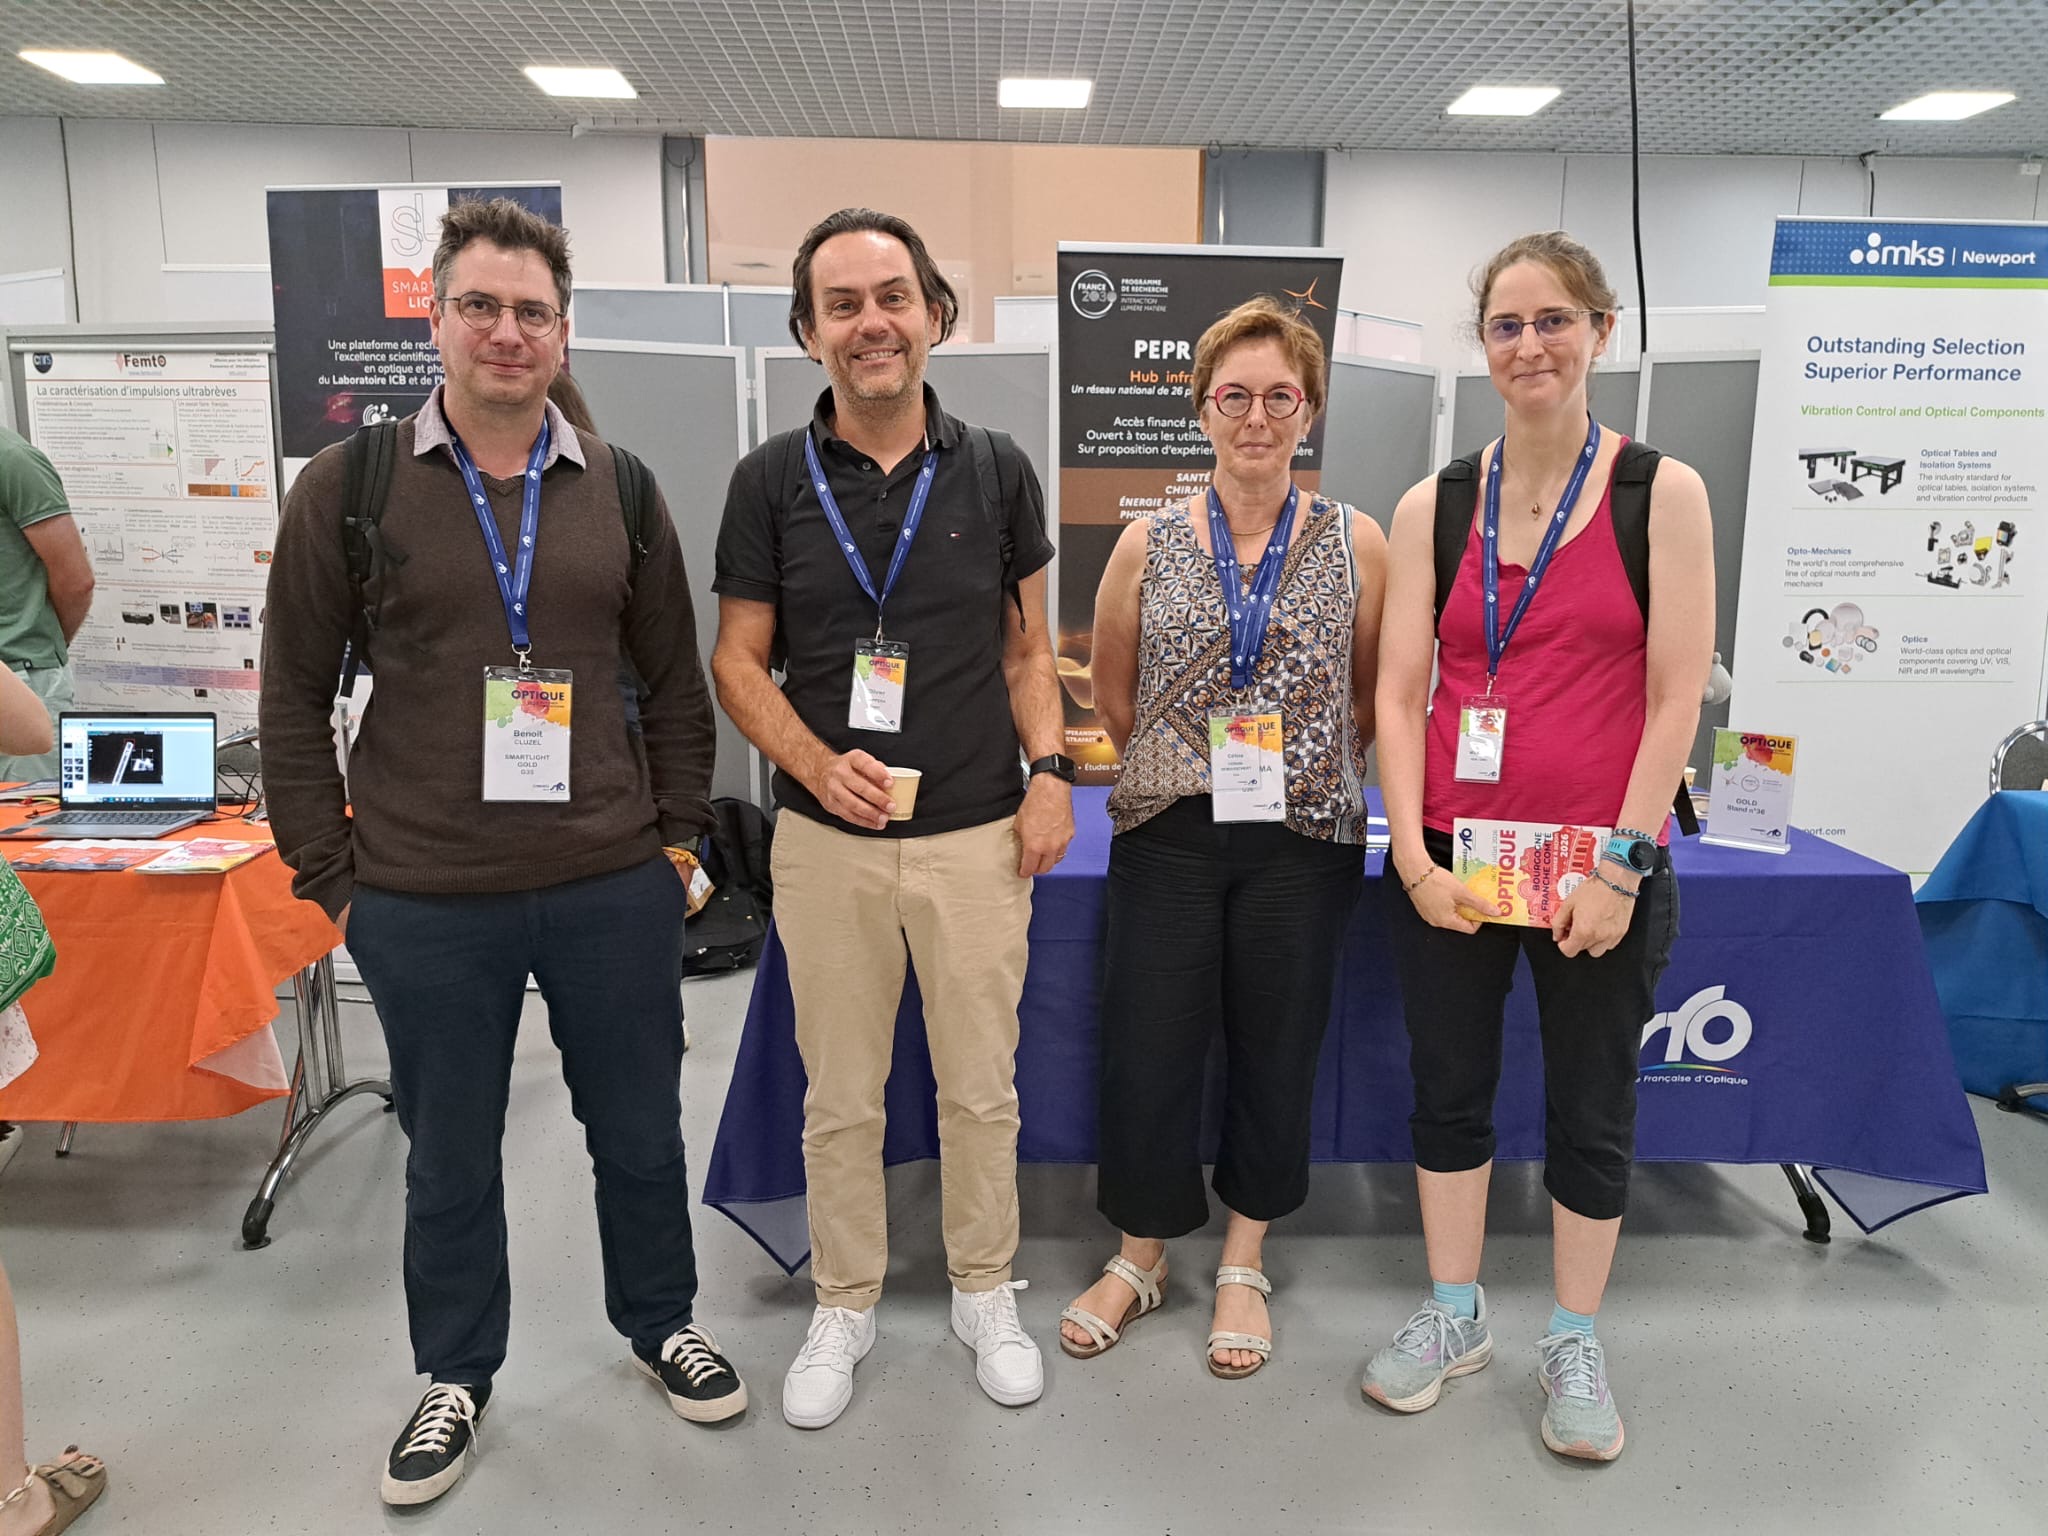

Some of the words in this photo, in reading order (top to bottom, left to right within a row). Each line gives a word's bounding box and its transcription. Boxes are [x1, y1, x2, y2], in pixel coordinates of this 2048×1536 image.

[1881, 240, 1945, 267] mks
[1962, 250, 2036, 267] Newport
[1077, 282, 1107, 291] FRANCE
[1121, 278, 1162, 286] PROGRAMME
[328, 339, 347, 349] Une
[349, 339, 399, 351] plateforme
[400, 339, 413, 349] de
[1134, 339, 1191, 360] PEPR
[1807, 336, 1926, 359] Outstanding
[1932, 338, 2026, 355] Selection
[334, 351, 386, 361] l'excellence
[388, 351, 441, 362] scientifique
[364, 365, 376, 373] en
[377, 363, 413, 375] optique
[415, 364, 425, 373] et
[1804, 362, 1889, 383] Superior
[1893, 363, 2022, 381] Performance
[318, 375, 330, 385] du
[332, 374, 387, 385] Laboratoire
[388, 375, 407, 385] ICB
[408, 375, 419, 385] et
[420, 375, 432, 385] de
[1130, 370, 1159, 383] Hub
[37, 385, 48, 396] La
[49, 385, 119, 396] caractérisation
[120, 385, 181, 397] d'impulsions
[182, 385, 238, 397] ultrabrèves
[1071, 385, 1084, 394] Un
[1085, 384, 1116, 395] réseau
[1117, 385, 1155, 395] national
[1156, 386, 1170, 395] de
[1170, 386, 1183, 396] 26
[1800, 405, 1853, 416] Vibration
[1856, 405, 1897, 417] Control
[1899, 406, 1922, 417] and
[1924, 406, 1967, 419] Optical
[1969, 407, 2045, 419] Components
[1113, 416, 1145, 427] Accès
[1147, 416, 1186, 428] financé
[1086, 429, 1124, 440] Ouvert
[1126, 430, 1133, 441] à
[1135, 431, 1158, 441] tous
[1160, 431, 1175, 441] les
[1078, 443, 1095, 455] Sur
[1098, 444, 1159, 456] proposition
[1920, 449, 1951, 458] Optical
[1953, 449, 1980, 457] Tables
[1981, 449, 1997, 457] and
[1919, 461, 1955, 469] Isolation
[1957, 461, 1991, 470] Systems
[1175, 471, 1211, 482] SANTÉ
[1919, 473, 1933, 481] The
[1934, 473, 1964, 482] industry
[1966, 473, 1999, 481] standard
[2001, 473, 2012, 481] for
[1916, 484, 1943, 492] optical
[1971, 484, 2002, 492] isolation
[1119, 496, 1162, 507] ÉNERGIE
[1916, 494, 1931, 502] and
[1932, 494, 1965, 502] vibration
[1966, 494, 1992, 502] control
[1993, 495, 2028, 503] products
[1787, 547, 1852, 556] Opto-Mechanics
[1787, 559, 1800, 567] The
[1848, 560, 1904, 568] comprehensive
[1809, 570, 1833, 578] optical
[1783, 580, 1824, 588] mechanics
[1901, 635, 1929, 644] Optics
[1900, 647, 1944, 655] World-class
[1945, 647, 1969, 656] optics
[1969, 647, 1985, 655] and
[1985, 647, 2012, 656] optical
[1898, 658, 1945, 666] components
[1946, 658, 1978, 666] covering
[1898, 667, 1913, 675] NIR
[1913, 667, 1929, 675] and
[1929, 667, 1938, 675] IR
[1939, 667, 1985, 676] wavelengths
[511, 689, 565, 701] OPTIQUE
[1740, 736, 1793, 750] OPTIQUE
[1084, 762, 1110, 771] Études
[1111, 762, 1122, 771] de
[1736, 798, 1758, 807] GOLD
[1727, 804, 1748, 813] Stand
[1560, 833, 1570, 858] 2026
[1532, 831, 1543, 891] BOURGOGNE
[1497, 829, 1516, 917] OPTIQUE
[1541, 866, 1551, 911] FRANCHE
[1643, 1074, 1692, 1083] Française
[1694, 1074, 1749, 1085] d'Optique
